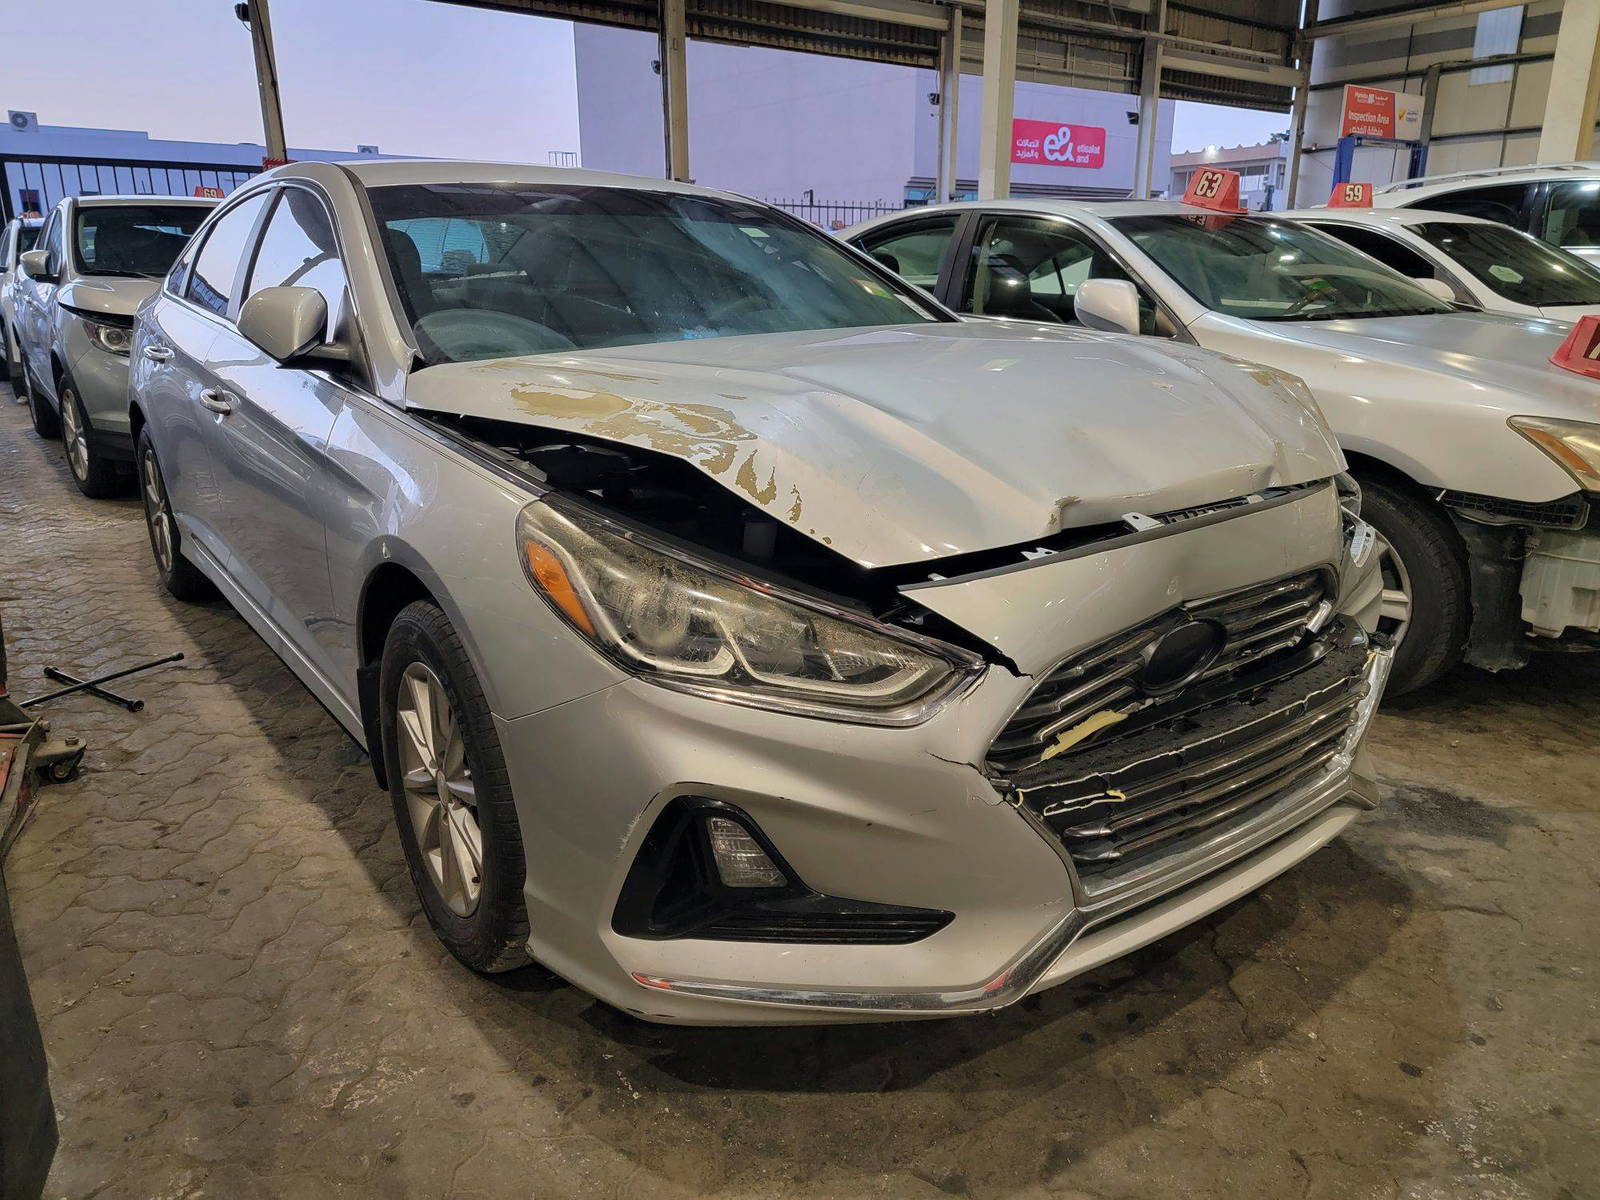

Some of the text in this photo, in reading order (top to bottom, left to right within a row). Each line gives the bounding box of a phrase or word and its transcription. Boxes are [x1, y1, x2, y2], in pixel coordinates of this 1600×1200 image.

[1348, 110, 1389, 125] Inspection Area
[1077, 144, 1100, 154] etisalat
[1076, 155, 1089, 163] and
[1195, 171, 1223, 198] 63
[1345, 184, 1363, 202] 59
